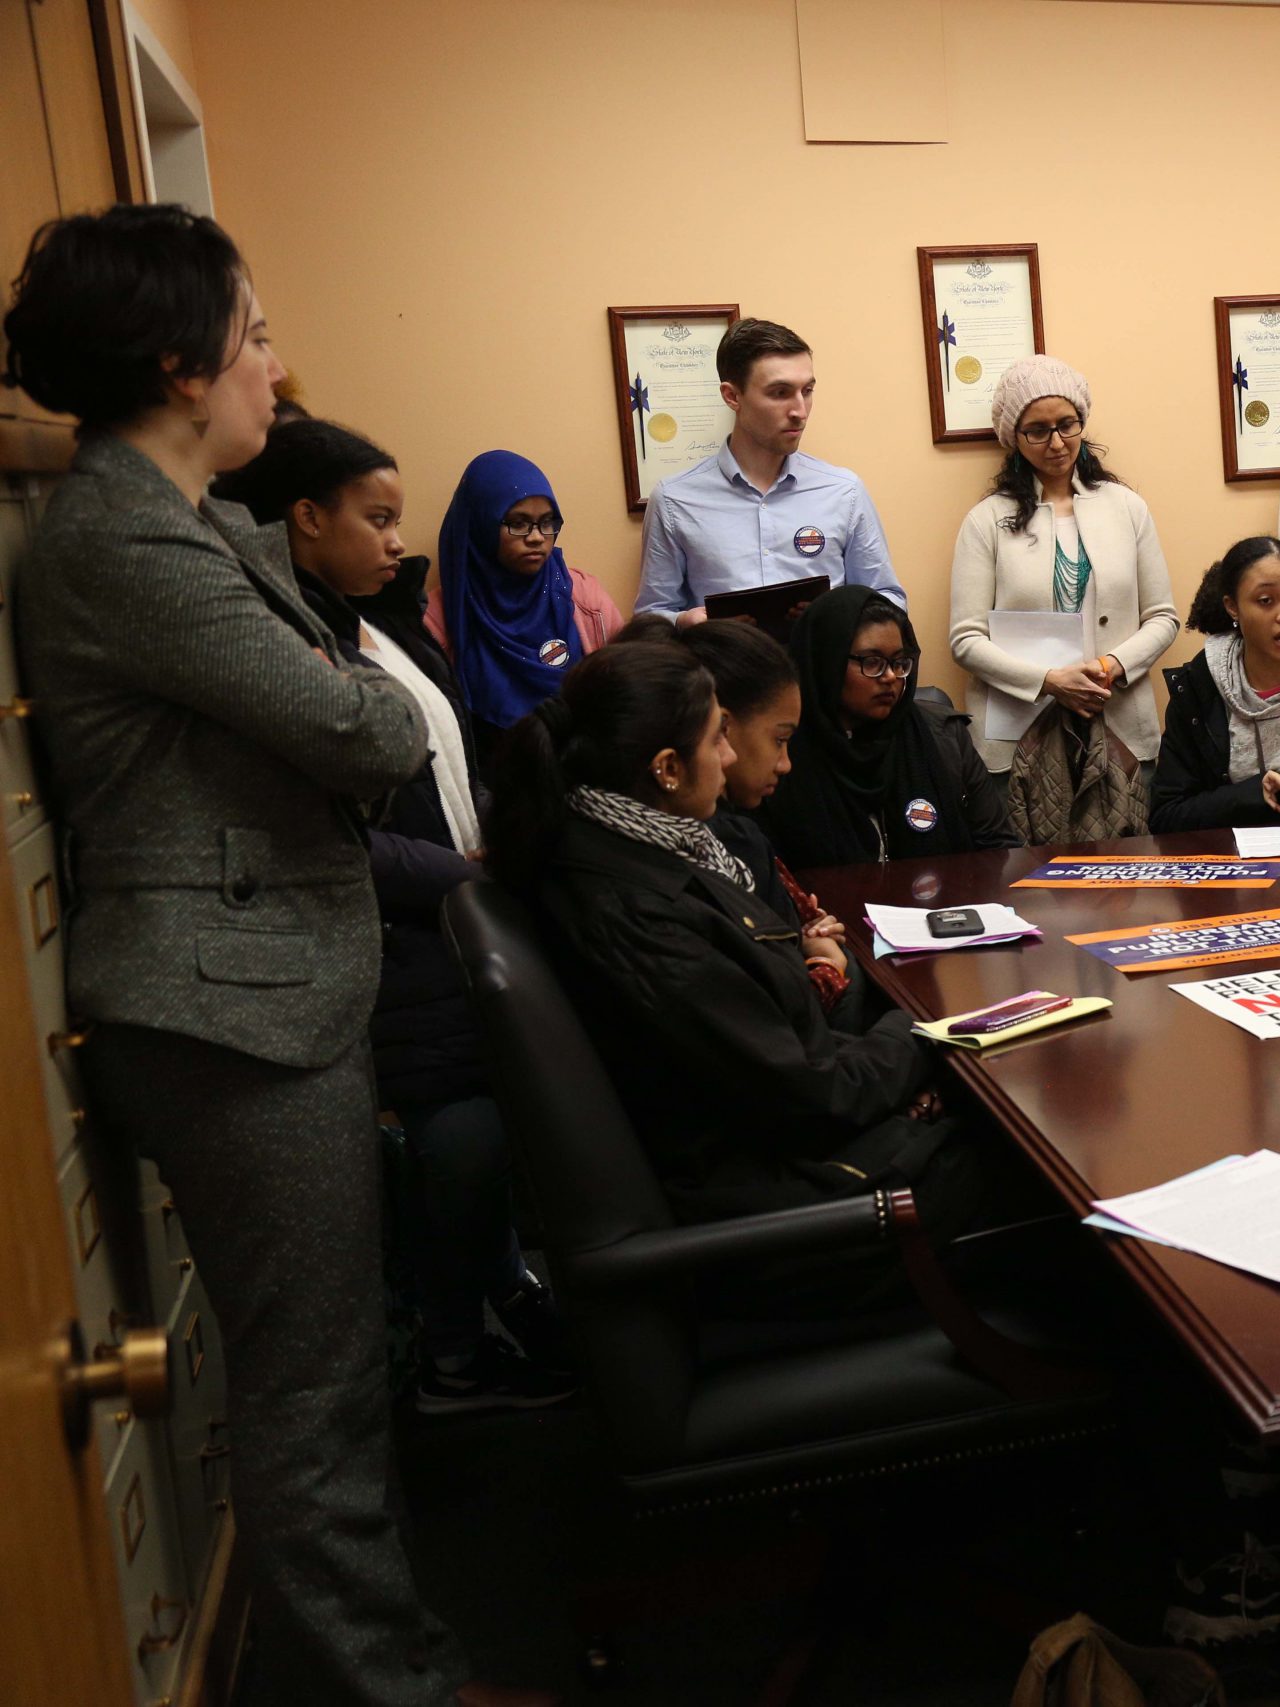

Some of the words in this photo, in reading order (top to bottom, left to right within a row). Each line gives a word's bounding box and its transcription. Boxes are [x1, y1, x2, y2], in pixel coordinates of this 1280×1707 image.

[1175, 922, 1213, 930] USS
[1220, 915, 1268, 924] CUNY
[1108, 935, 1218, 953] PUBLIC
[1150, 942, 1209, 955] NOT
